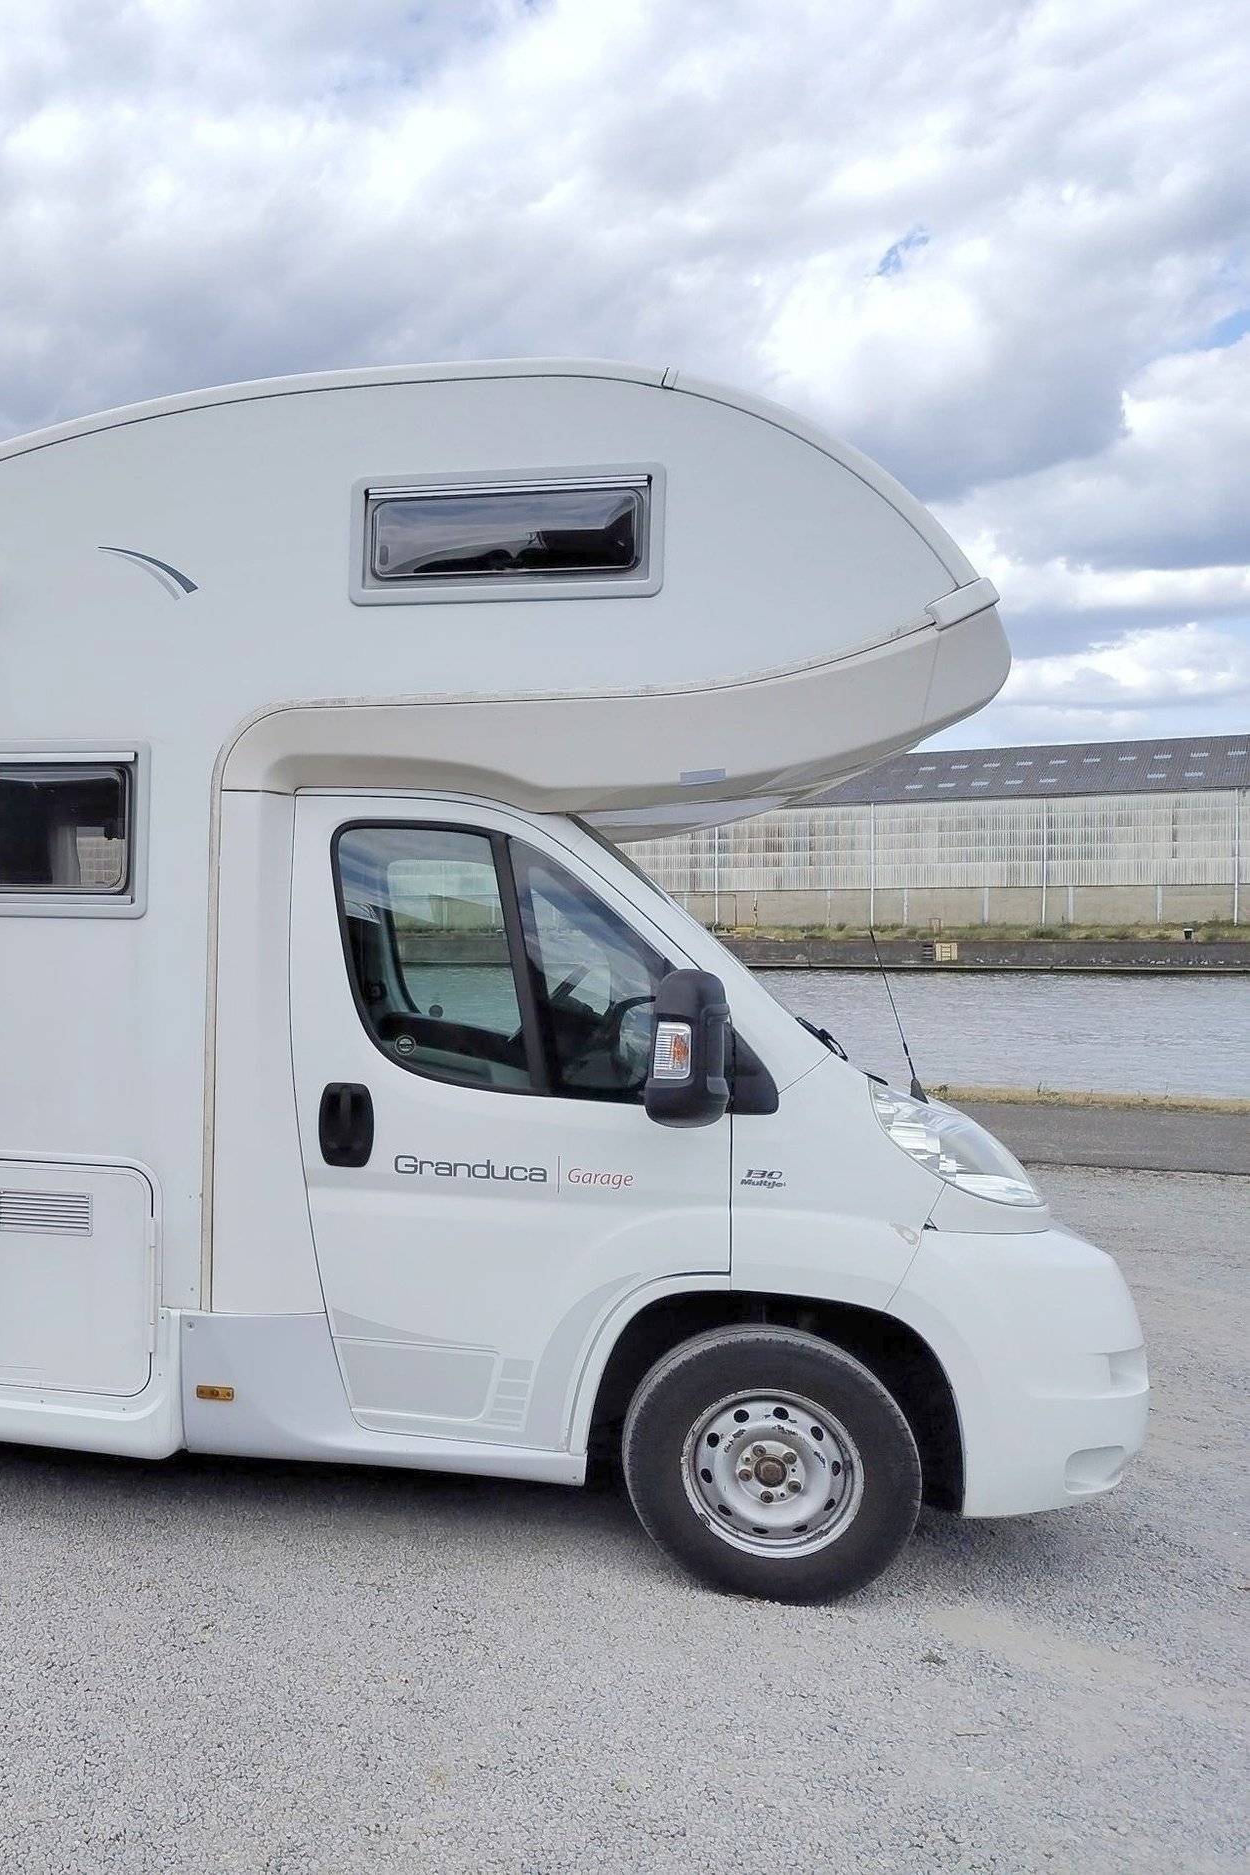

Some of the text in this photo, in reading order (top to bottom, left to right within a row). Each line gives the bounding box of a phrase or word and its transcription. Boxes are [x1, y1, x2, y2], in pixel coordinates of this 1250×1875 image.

[394, 1154, 634, 1189] Granduca Garage
[745, 1169, 783, 1180] 130
